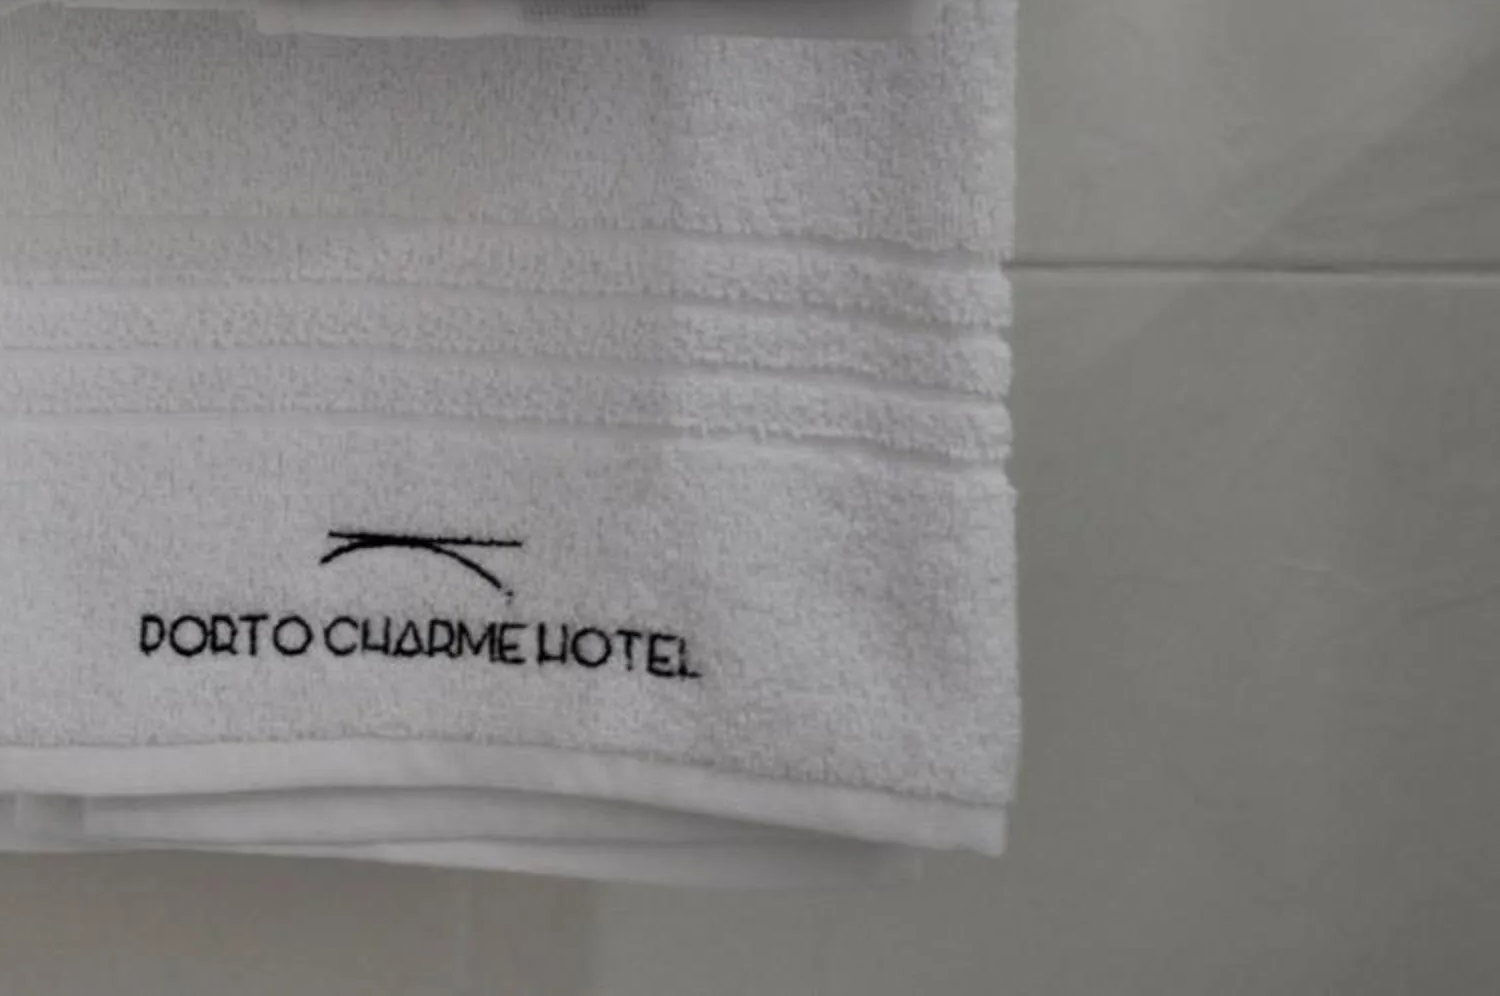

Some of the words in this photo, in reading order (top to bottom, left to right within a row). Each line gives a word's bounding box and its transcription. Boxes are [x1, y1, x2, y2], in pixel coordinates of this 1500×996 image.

[139, 613, 315, 658] PORTO
[323, 615, 528, 665] CHARME
[535, 621, 703, 680] HOTEL
